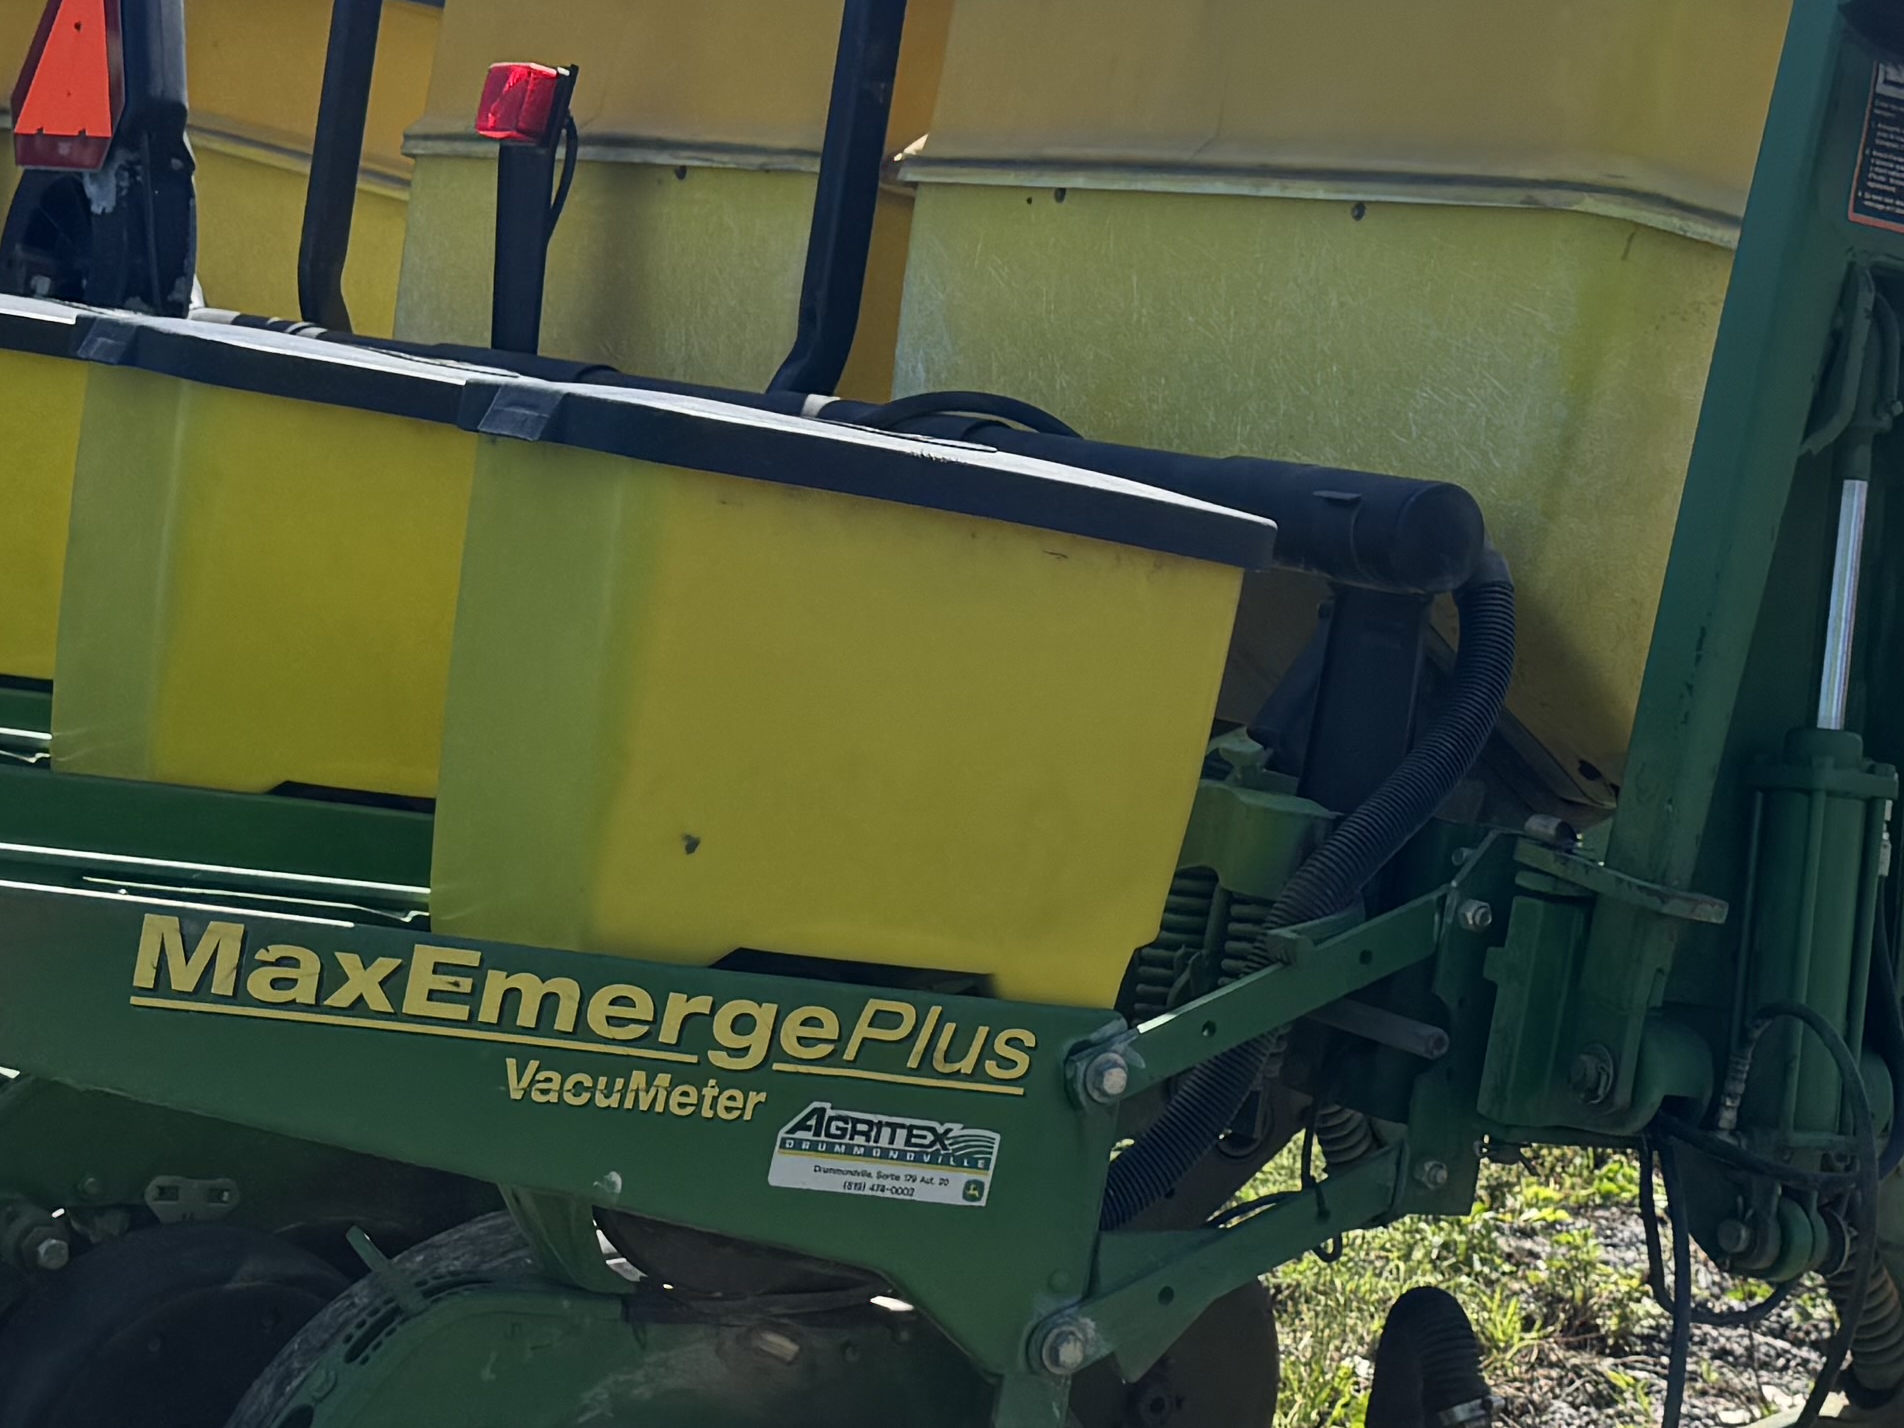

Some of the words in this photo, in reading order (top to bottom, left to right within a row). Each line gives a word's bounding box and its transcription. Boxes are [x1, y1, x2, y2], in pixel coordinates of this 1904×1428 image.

[505, 1057, 768, 1122] VacuMeter
[784, 1106, 954, 1151] AGRITEX
[784, 1139, 986, 1169] DRUMMONDVILLE
